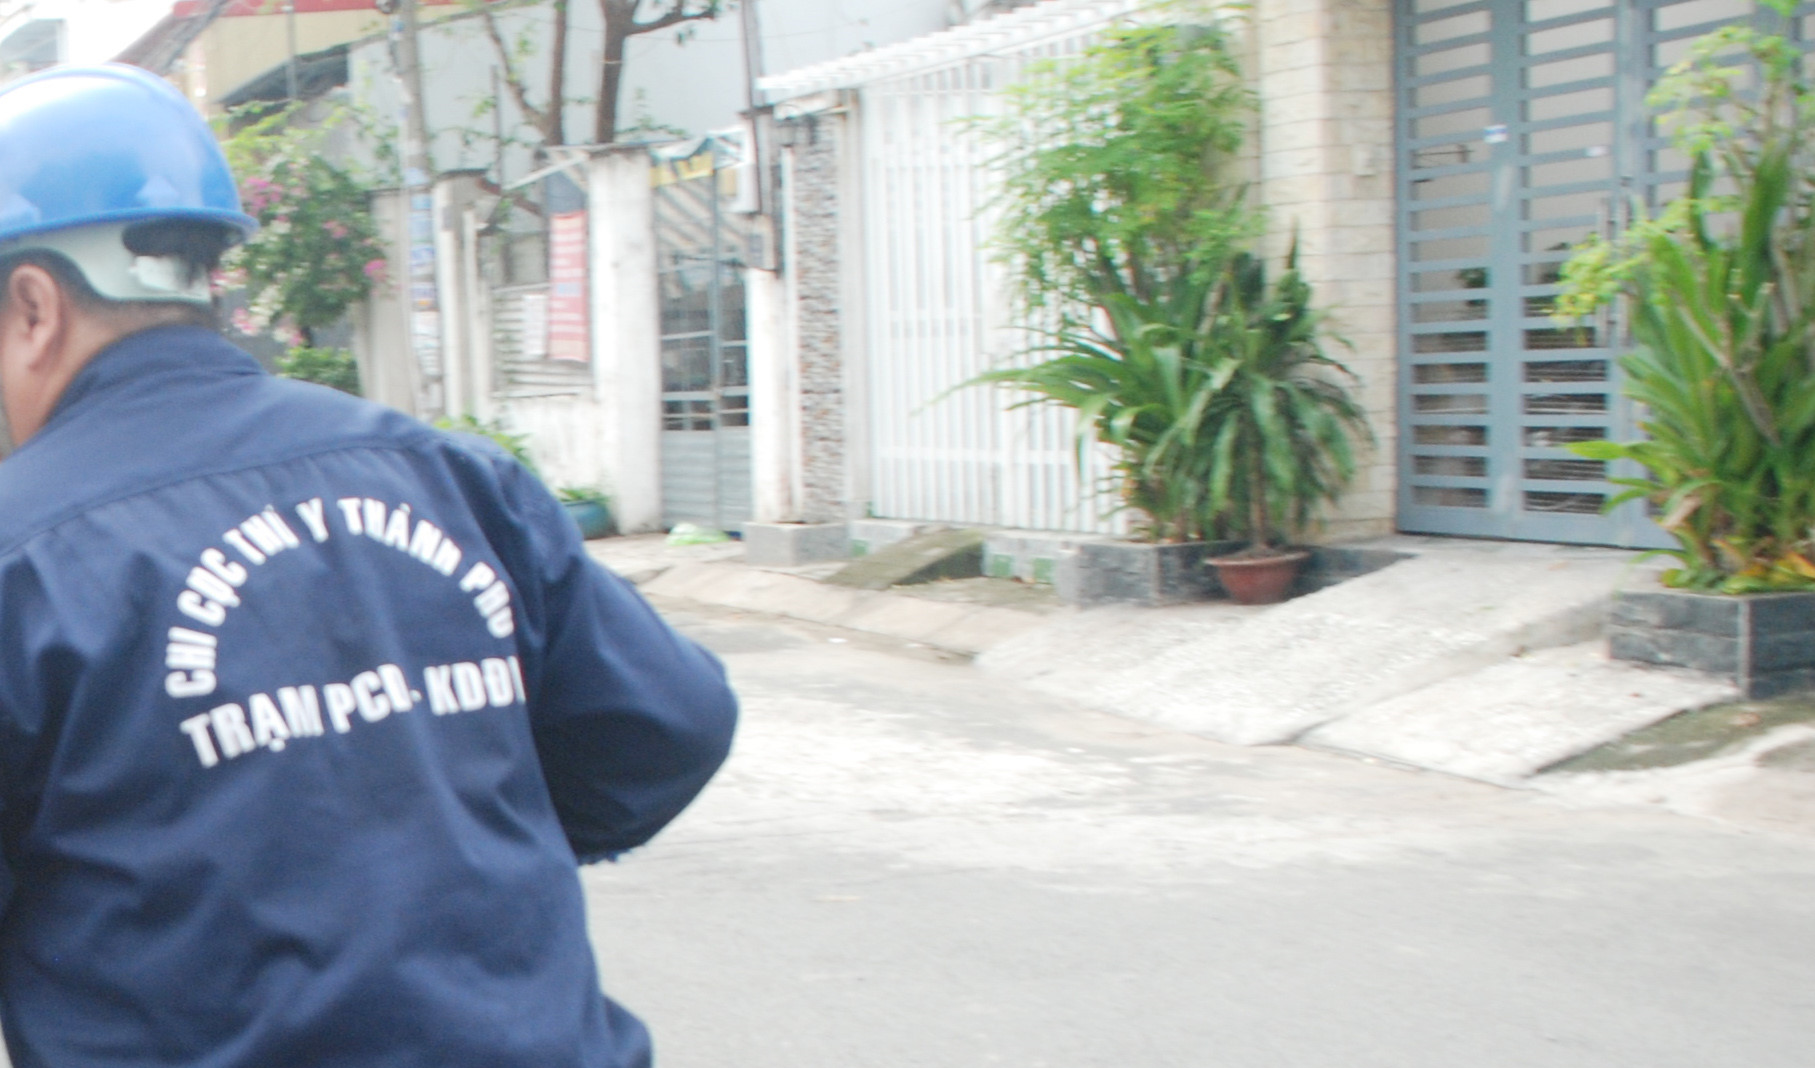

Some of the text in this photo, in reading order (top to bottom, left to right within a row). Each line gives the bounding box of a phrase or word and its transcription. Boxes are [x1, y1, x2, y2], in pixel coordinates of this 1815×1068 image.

[295, 495, 330, 543] Y
[175, 546, 250, 628] CỤC
[164, 625, 219, 699] CHI
[179, 683, 326, 768] TRẠM
